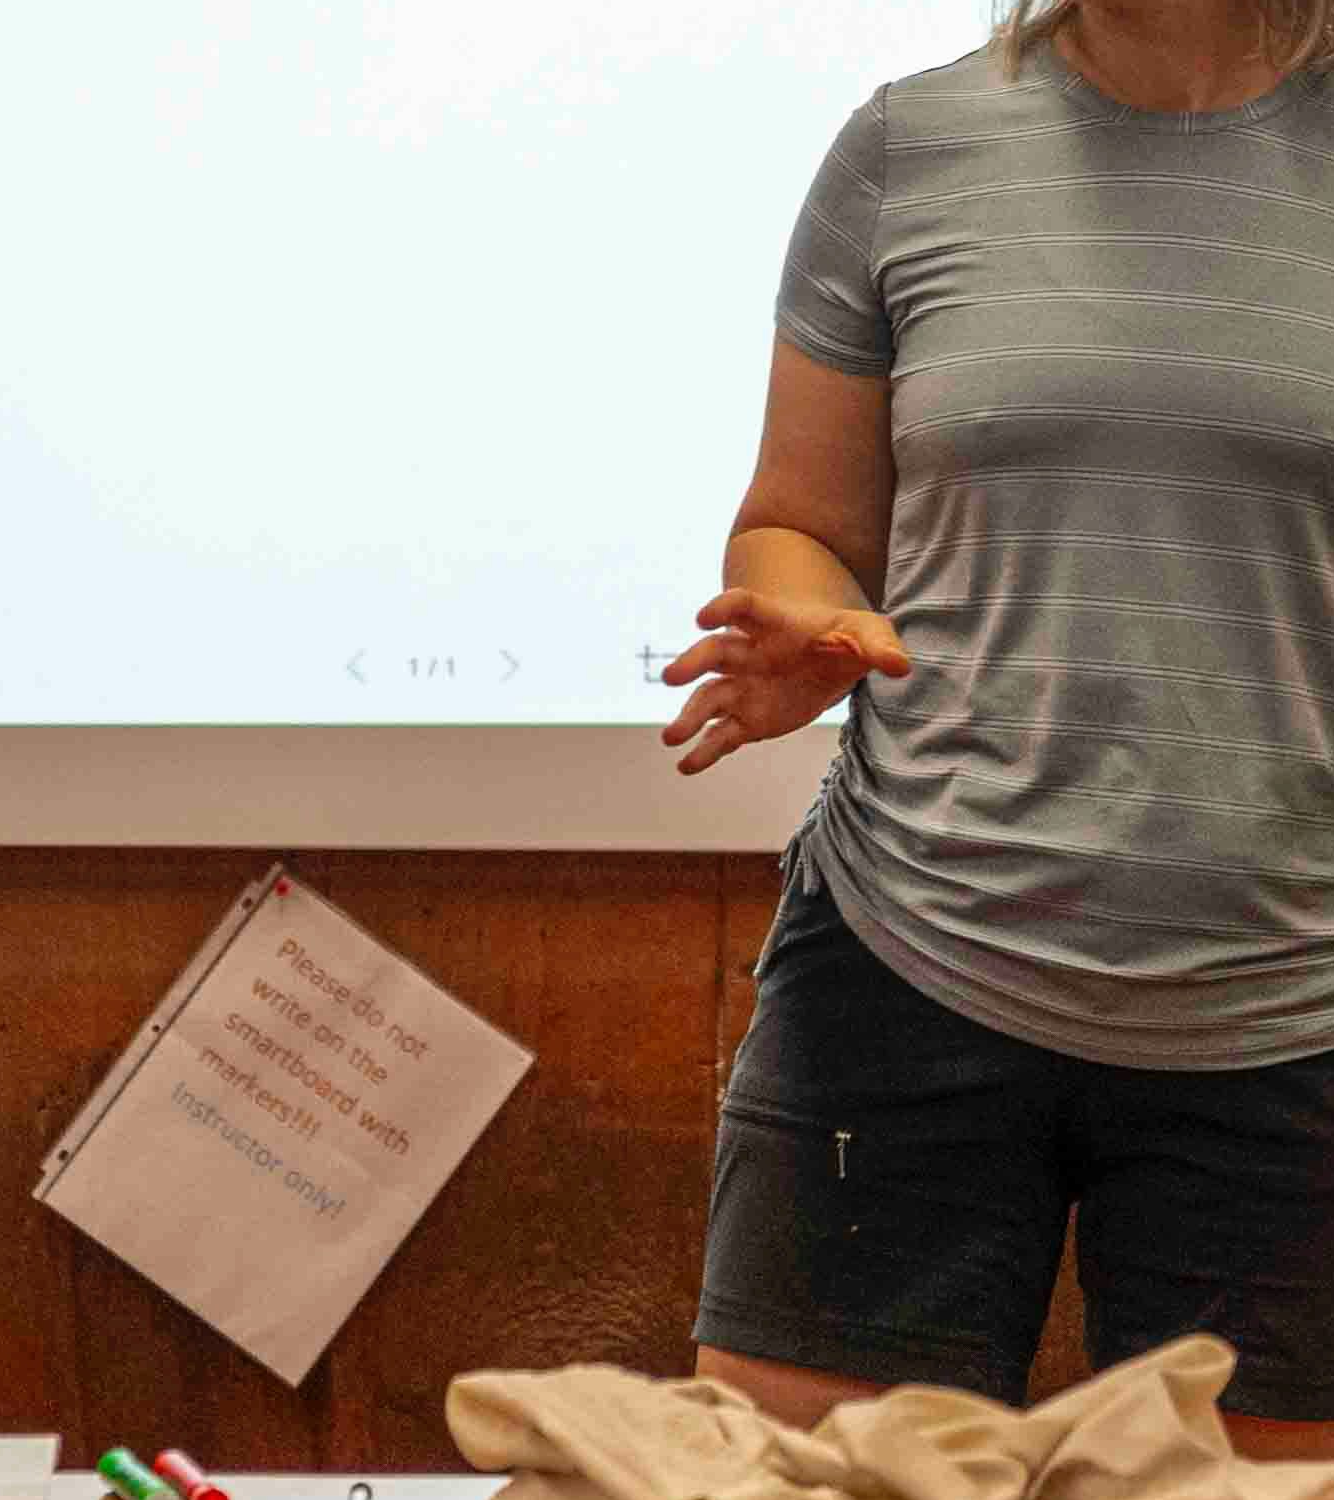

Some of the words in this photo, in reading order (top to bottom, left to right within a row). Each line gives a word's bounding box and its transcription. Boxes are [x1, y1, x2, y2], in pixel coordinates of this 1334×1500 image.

[251, 976, 312, 1030] write
[314, 1022, 347, 1054] on
[348, 1047, 389, 1086] the
[276, 937, 351, 1004] Please
[351, 998, 386, 1028] do
[385, 1022, 433, 1063] not
[170, 1080, 284, 1173] Instructor
[283, 1170, 348, 1220] only!
[224, 1012, 361, 1117] smartboard
[358, 1109, 413, 1156] with
